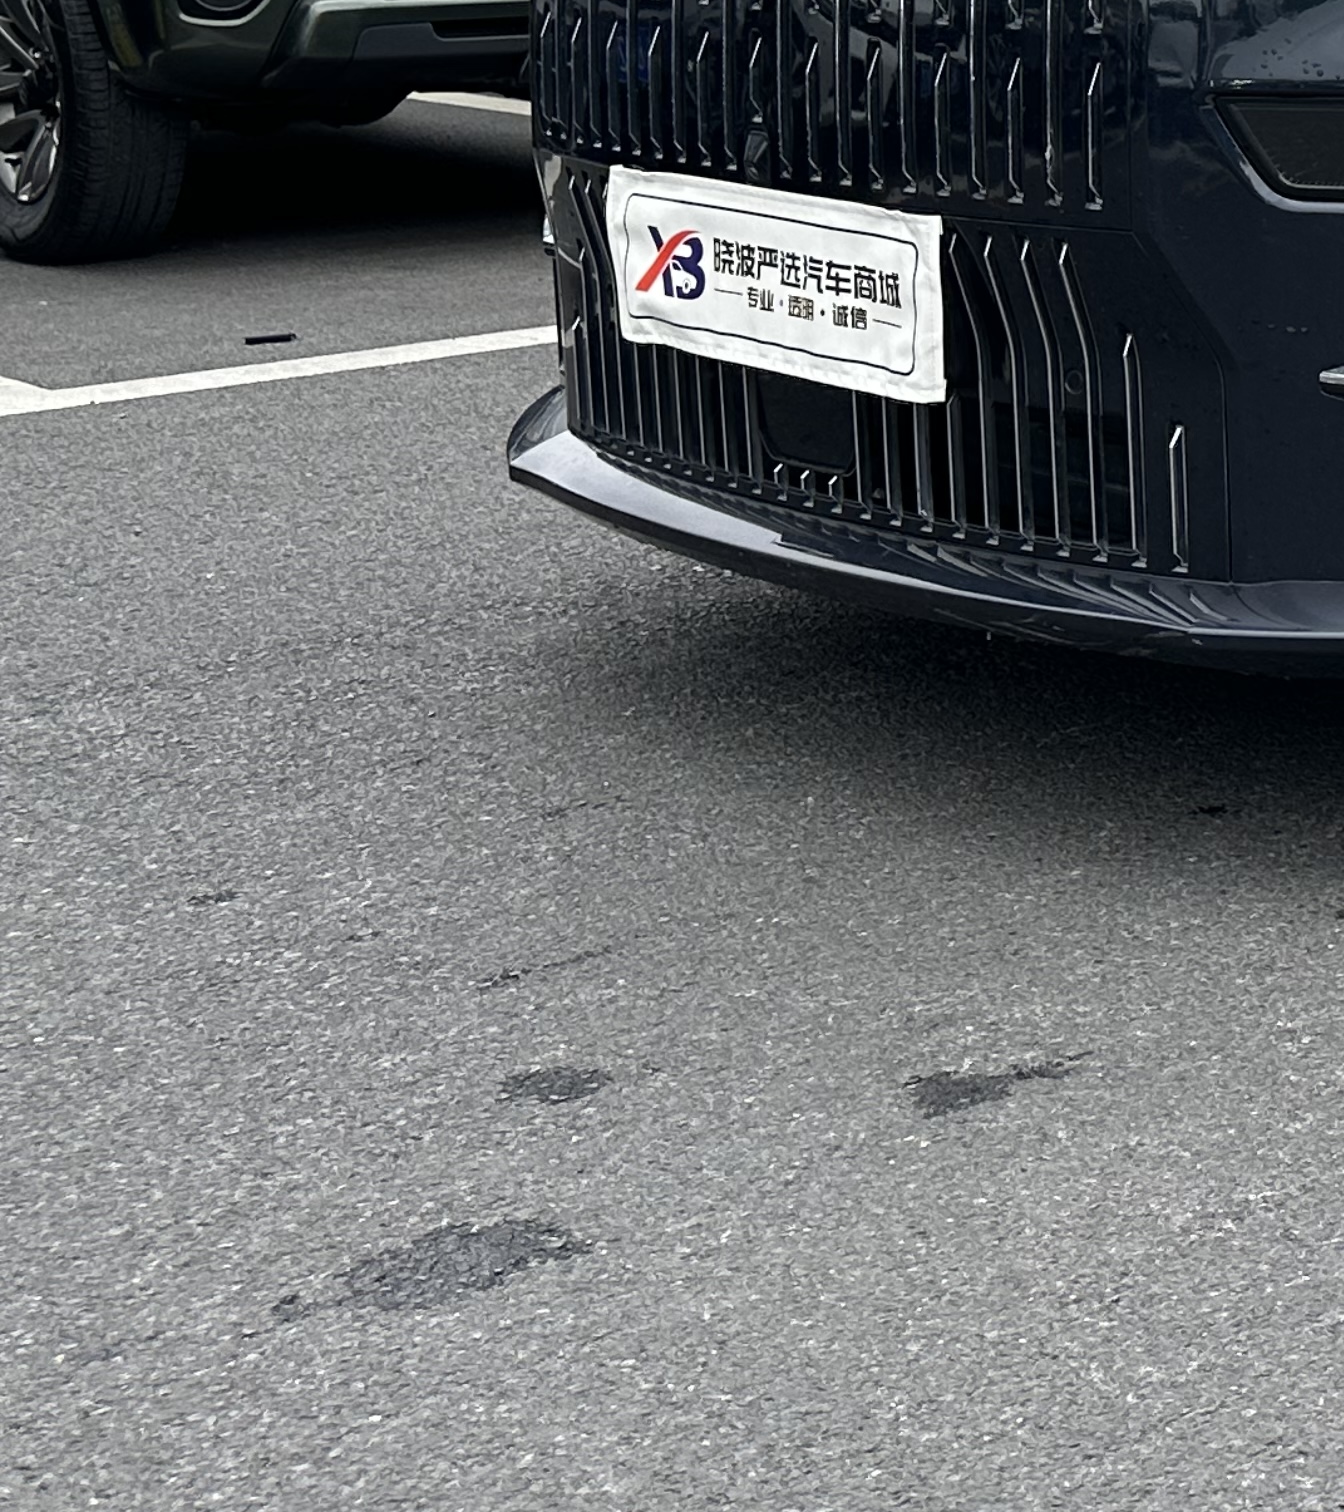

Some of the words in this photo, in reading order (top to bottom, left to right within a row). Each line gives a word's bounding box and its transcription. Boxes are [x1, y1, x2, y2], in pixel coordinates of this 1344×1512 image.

[713, 237, 901, 308] 晓波严选汽车商城
